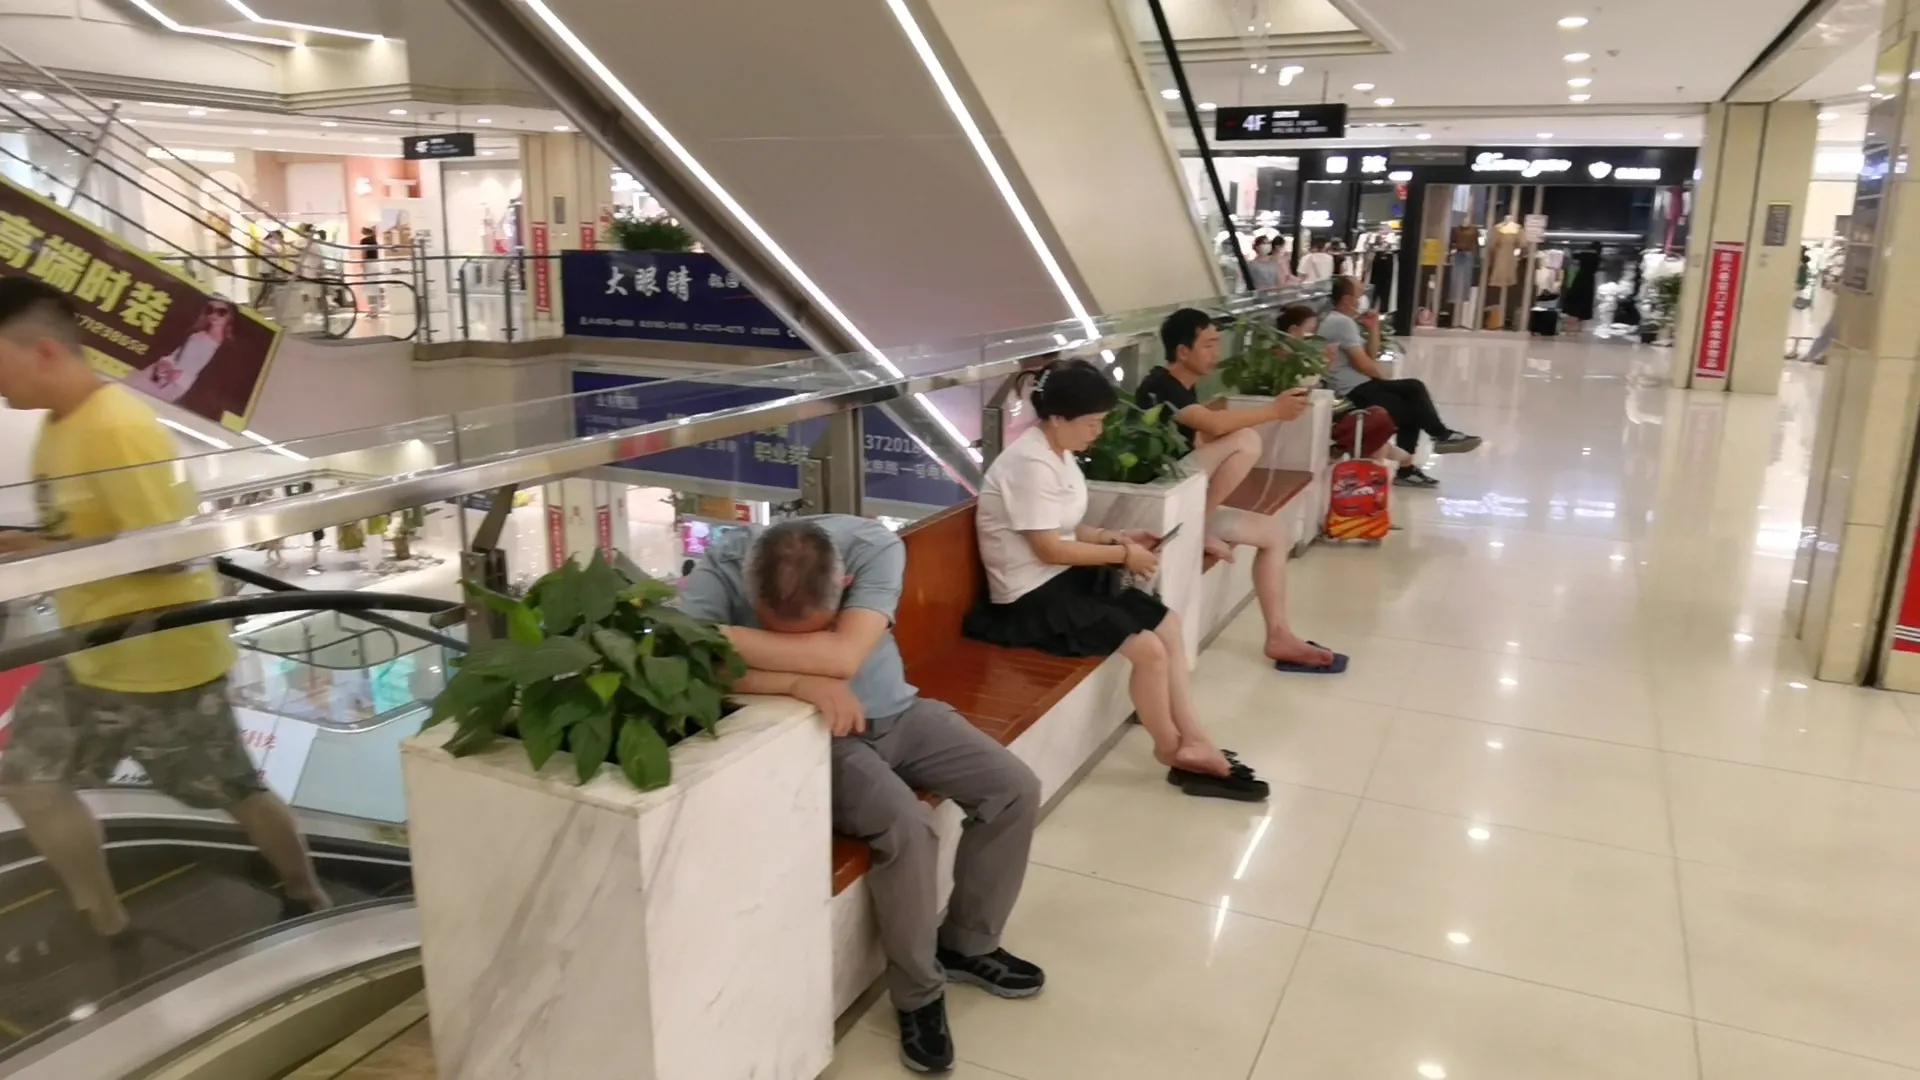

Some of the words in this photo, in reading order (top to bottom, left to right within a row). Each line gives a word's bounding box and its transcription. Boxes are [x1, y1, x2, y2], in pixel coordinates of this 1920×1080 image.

[1242, 114, 1267, 131] 4F
[0, 209, 174, 336] 高端时装
